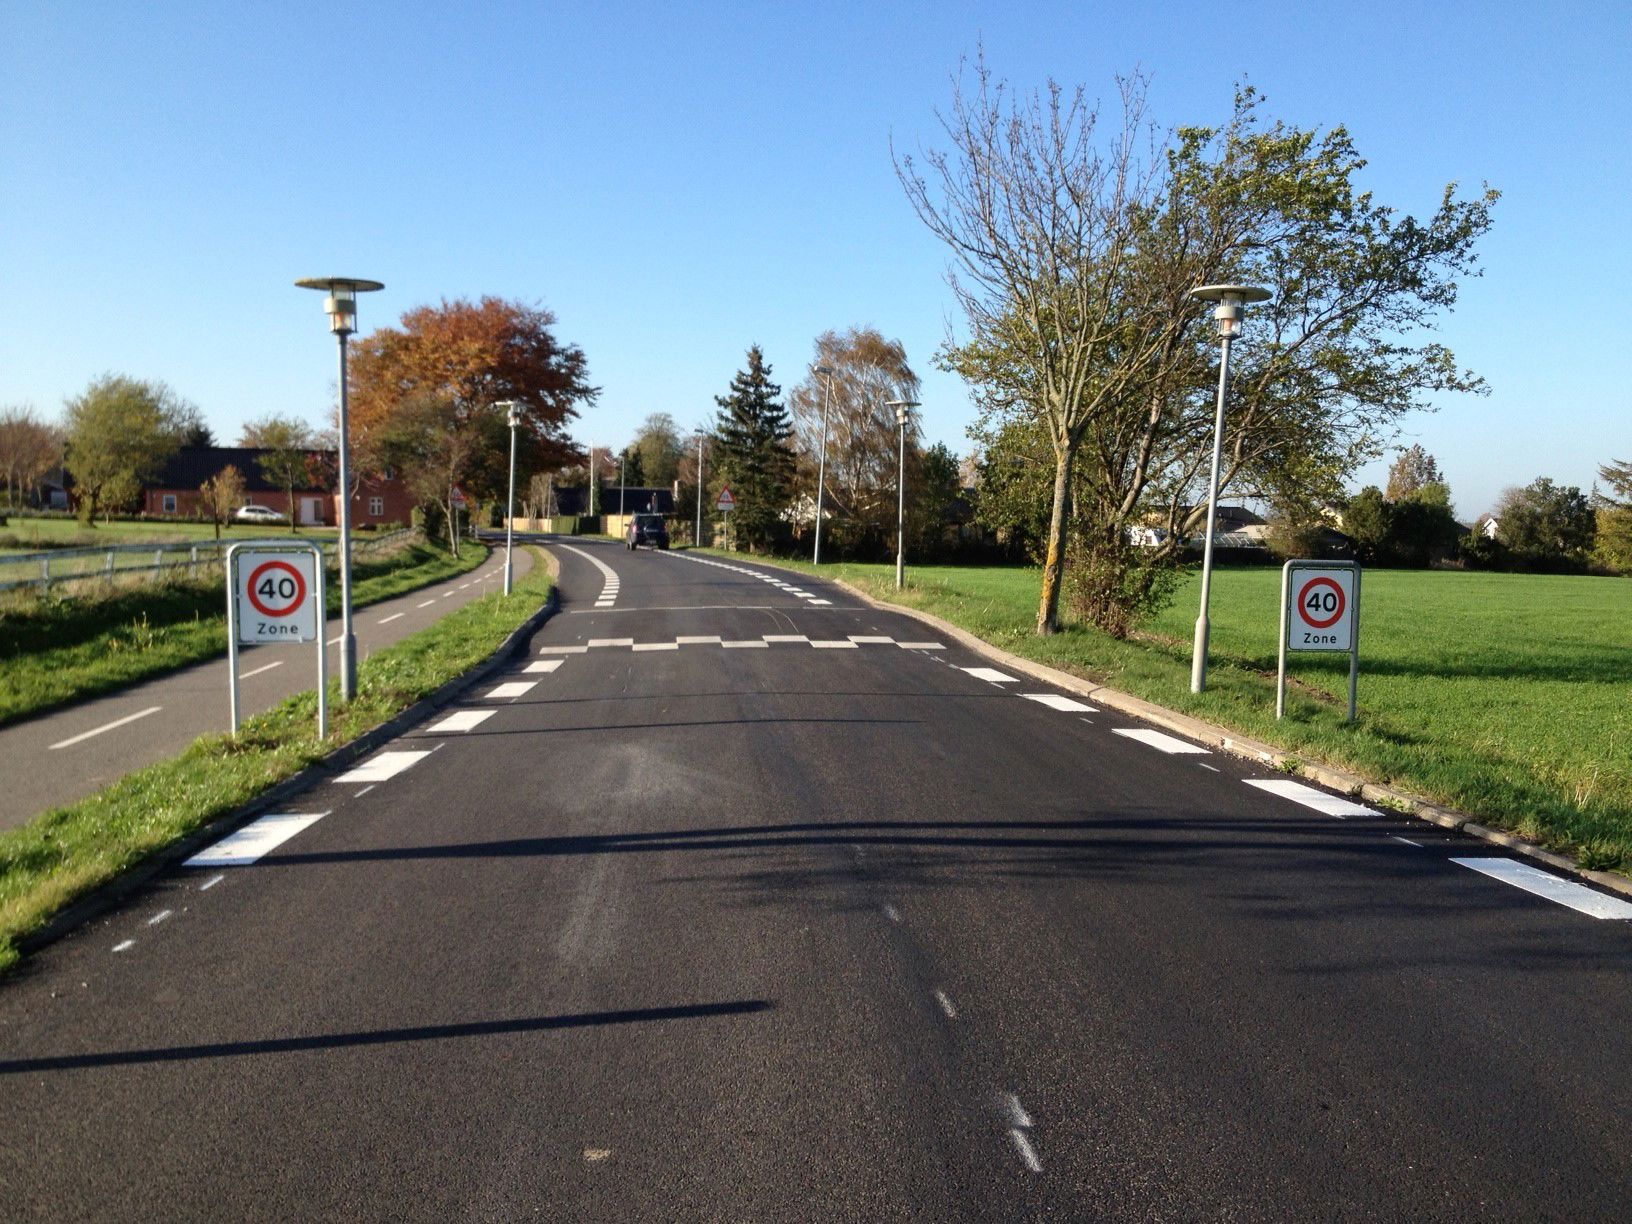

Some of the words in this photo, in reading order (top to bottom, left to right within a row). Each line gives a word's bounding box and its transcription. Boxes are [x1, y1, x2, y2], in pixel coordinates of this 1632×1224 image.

[259, 578, 295, 599] 40
[1307, 593, 1337, 612] 40
[257, 623, 297, 634] Zone
[1304, 633, 1336, 643] Zone
